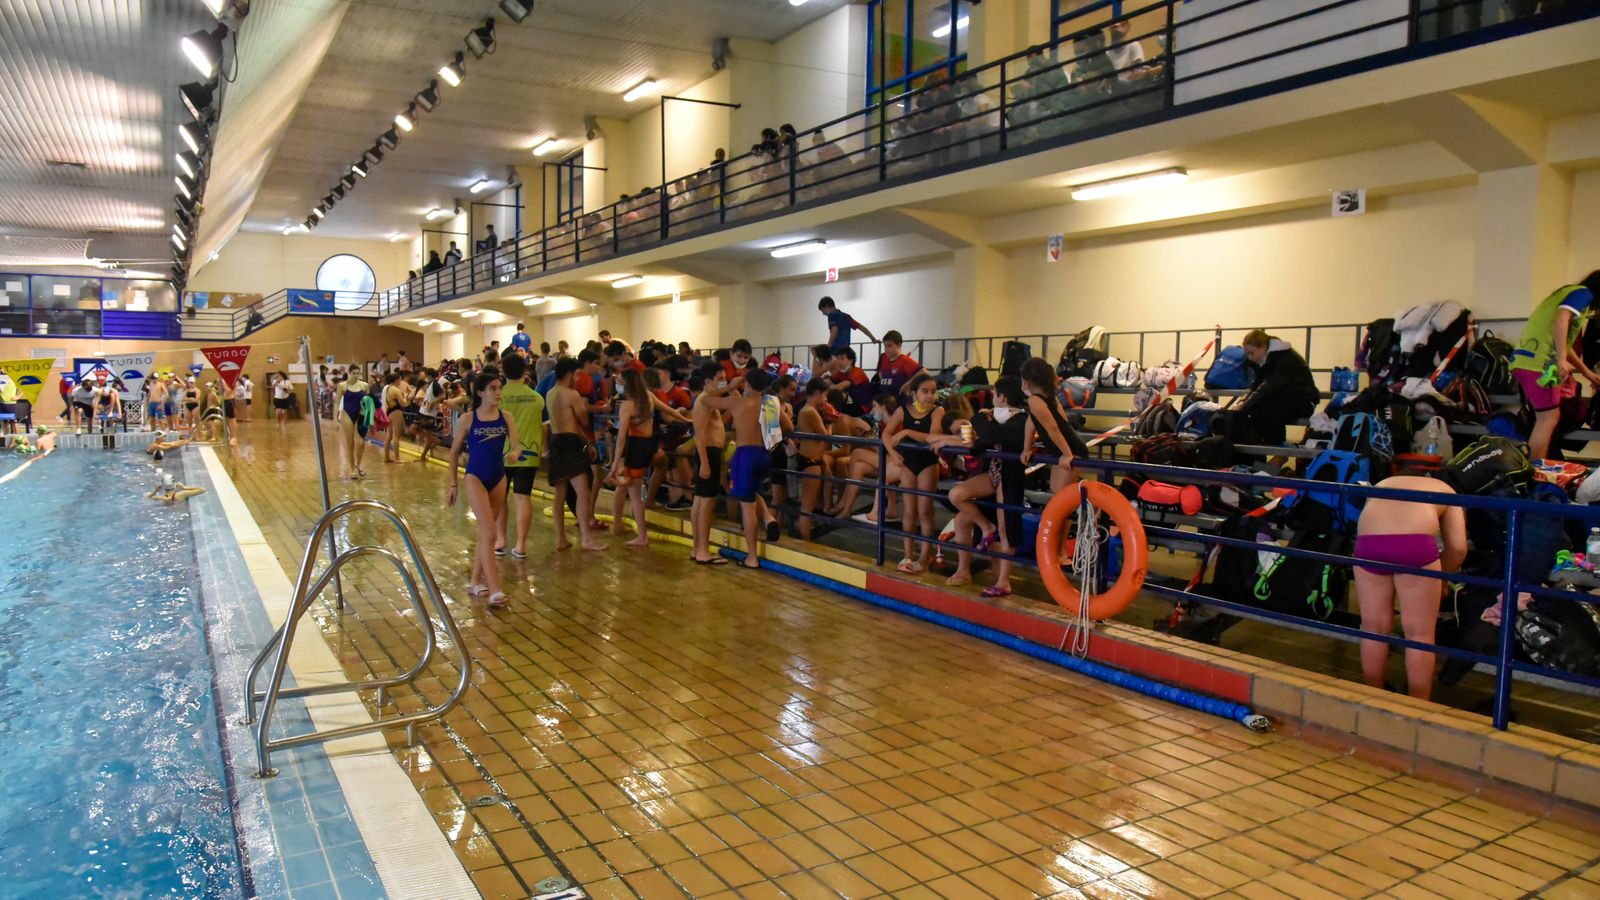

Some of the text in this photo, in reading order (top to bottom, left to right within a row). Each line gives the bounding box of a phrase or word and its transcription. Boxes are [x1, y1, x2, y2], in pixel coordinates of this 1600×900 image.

[206, 349, 248, 359] TURBO
[109, 356, 153, 367] TURBO
[4, 362, 52, 372] TURBO
